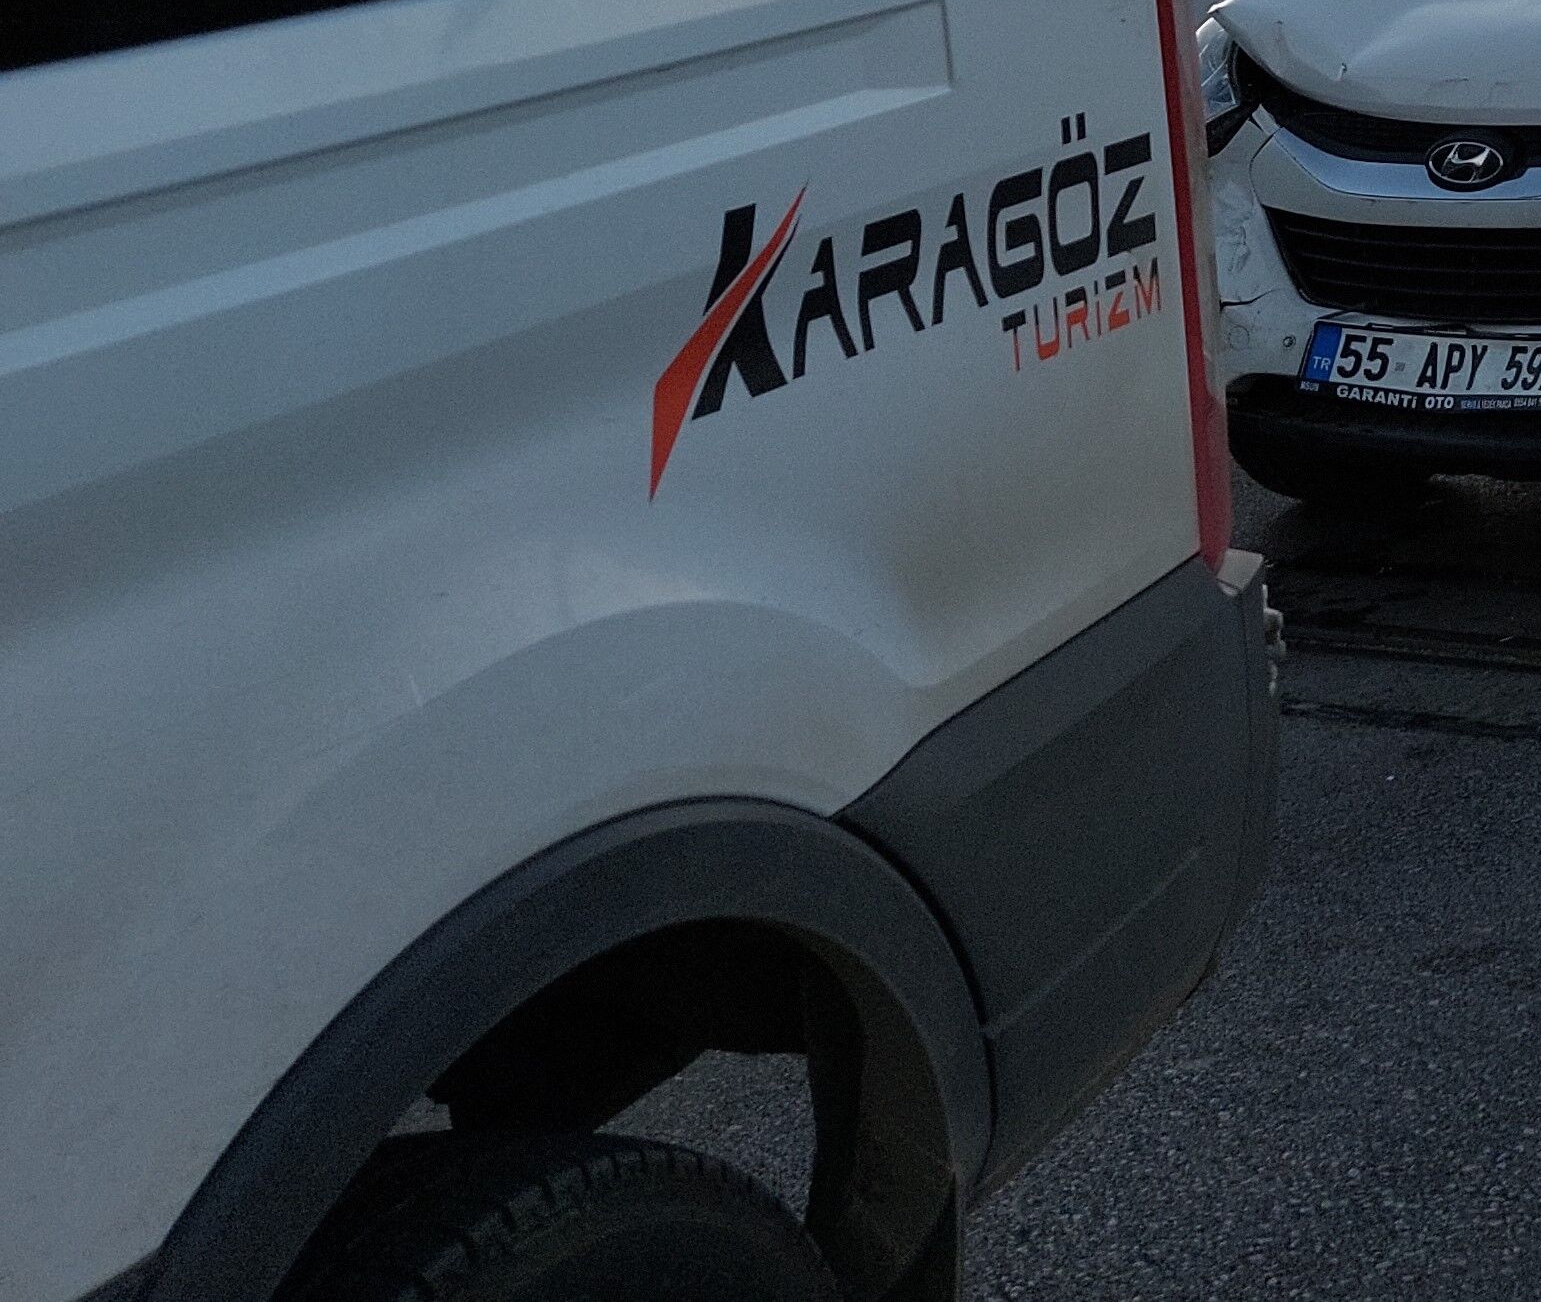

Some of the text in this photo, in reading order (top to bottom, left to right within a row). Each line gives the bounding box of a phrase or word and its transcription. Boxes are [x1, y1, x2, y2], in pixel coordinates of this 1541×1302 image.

[668, 112, 1157, 448] KARAGÖZ
[1002, 257, 1163, 372] TURİZM
[1313, 356, 1331, 371] TR
[1336, 333, 1394, 381] 55
[1415, 341, 1488, 391] APY
[1424, 396, 1455, 409] OTO
